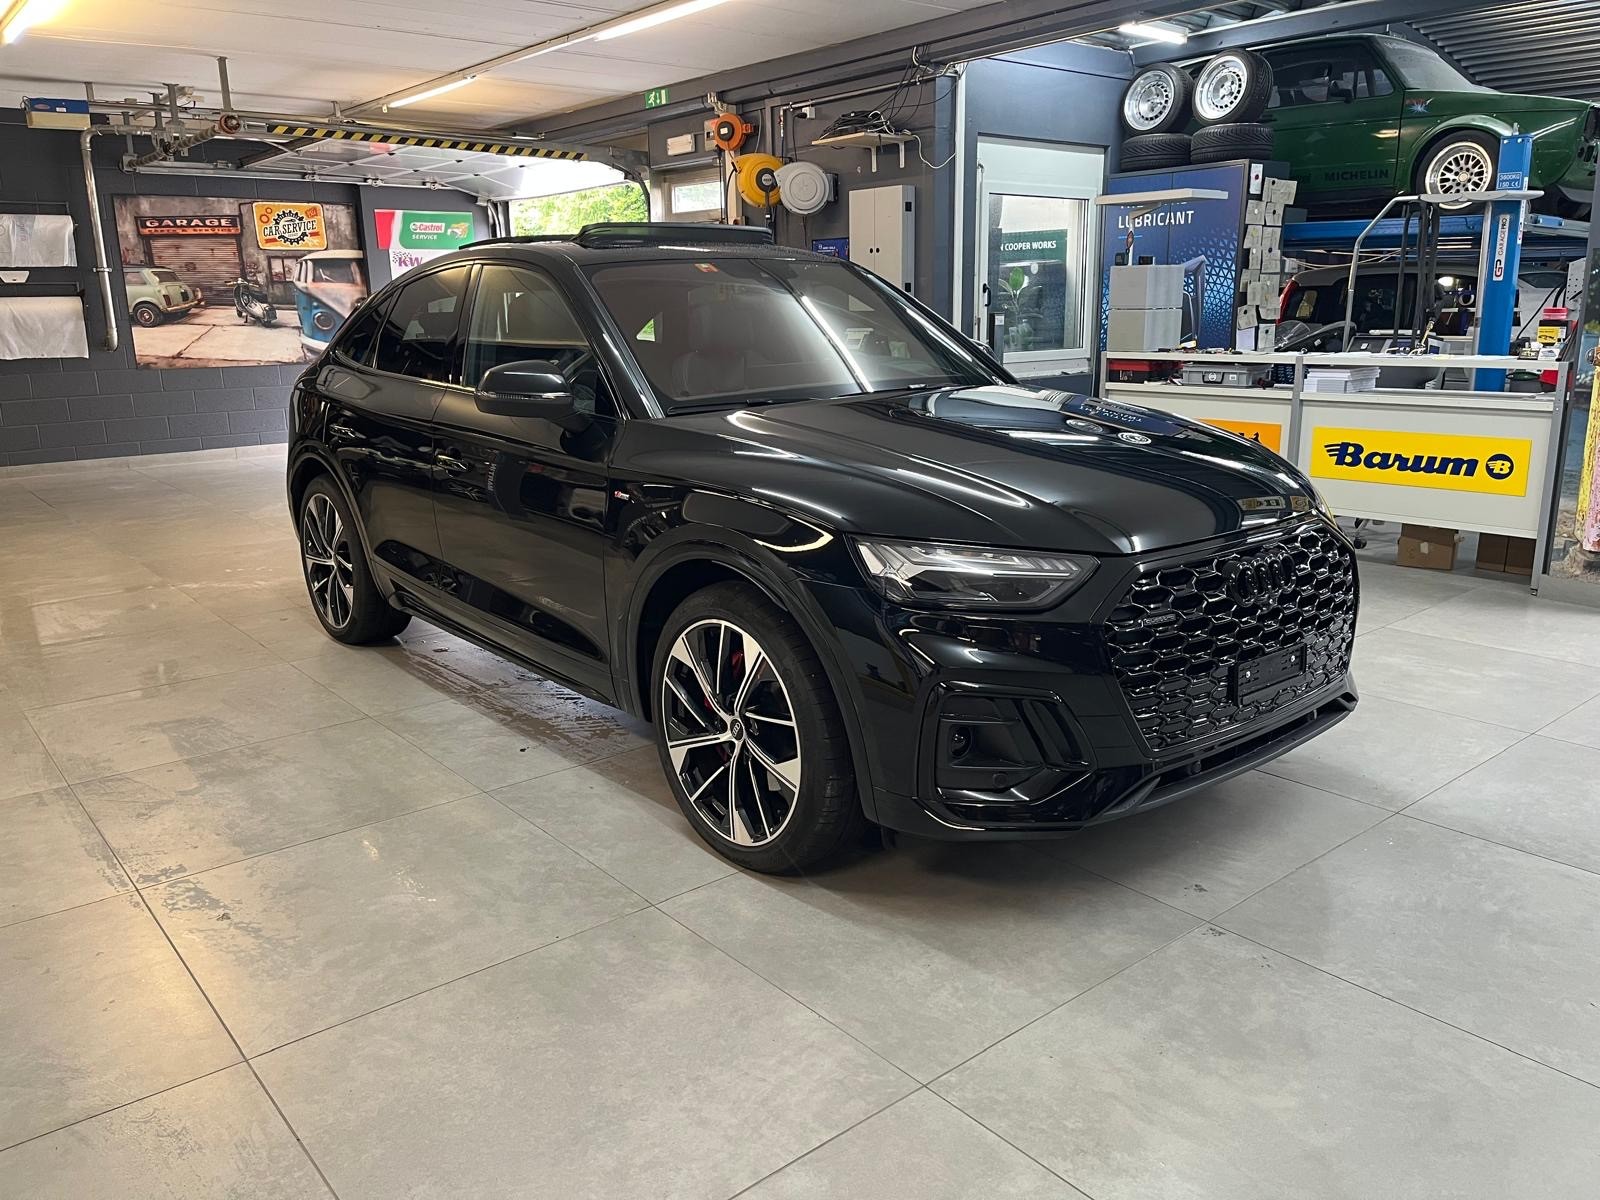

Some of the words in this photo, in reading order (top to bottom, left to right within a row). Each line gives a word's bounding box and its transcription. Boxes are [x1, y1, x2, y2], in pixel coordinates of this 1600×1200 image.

[1325, 169, 1389, 181] MICHELIN
[145, 219, 232, 227] GARAGE
[1118, 211, 1194, 229] LUBRICANT
[263, 225, 281, 237] CAR
[283, 220, 317, 234] SERVICE
[418, 223, 443, 232] Castrol
[1004, 242, 1031, 251] COOPER
[1032, 240, 1057, 250] WORKS
[1324, 442, 1479, 477] Barum
